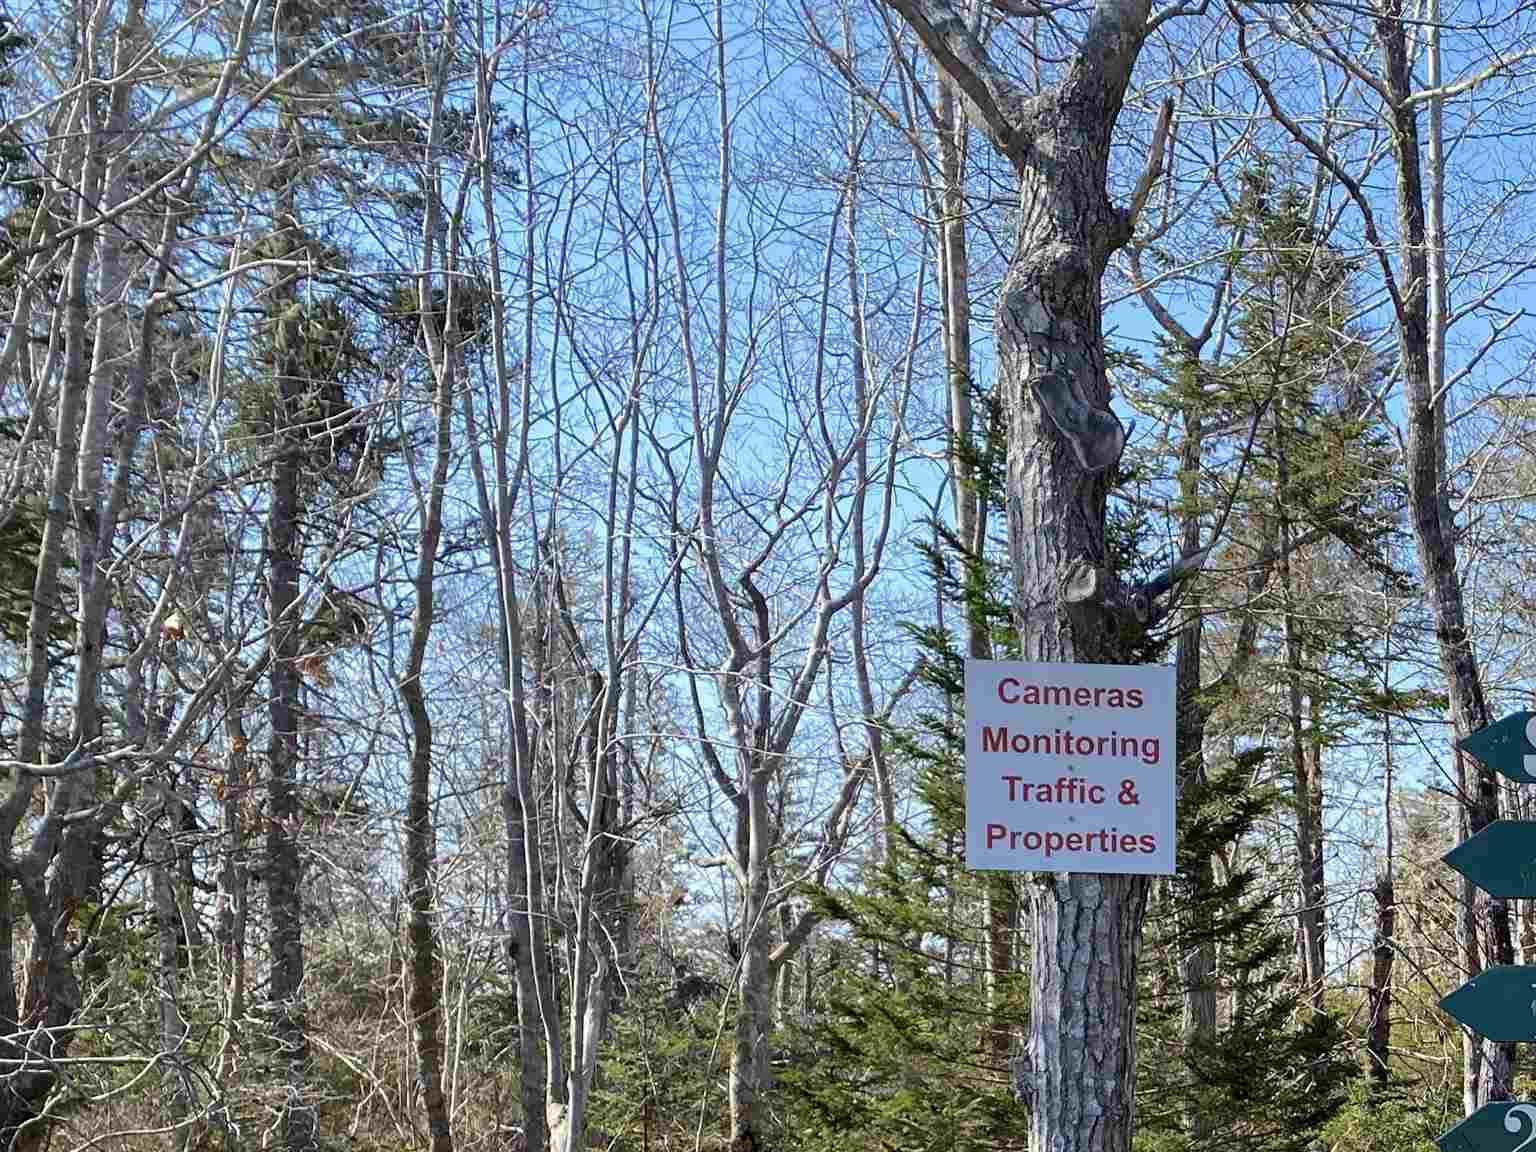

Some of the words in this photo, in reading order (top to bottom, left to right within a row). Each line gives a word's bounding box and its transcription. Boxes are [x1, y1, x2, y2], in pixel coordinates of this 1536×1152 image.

[998, 678, 1144, 708] Cameras
[982, 727, 1159, 764] Monitoring
[1002, 776, 1105, 804] Traffic
[1118, 779, 1140, 805] &
[986, 824, 1156, 857] Properties
